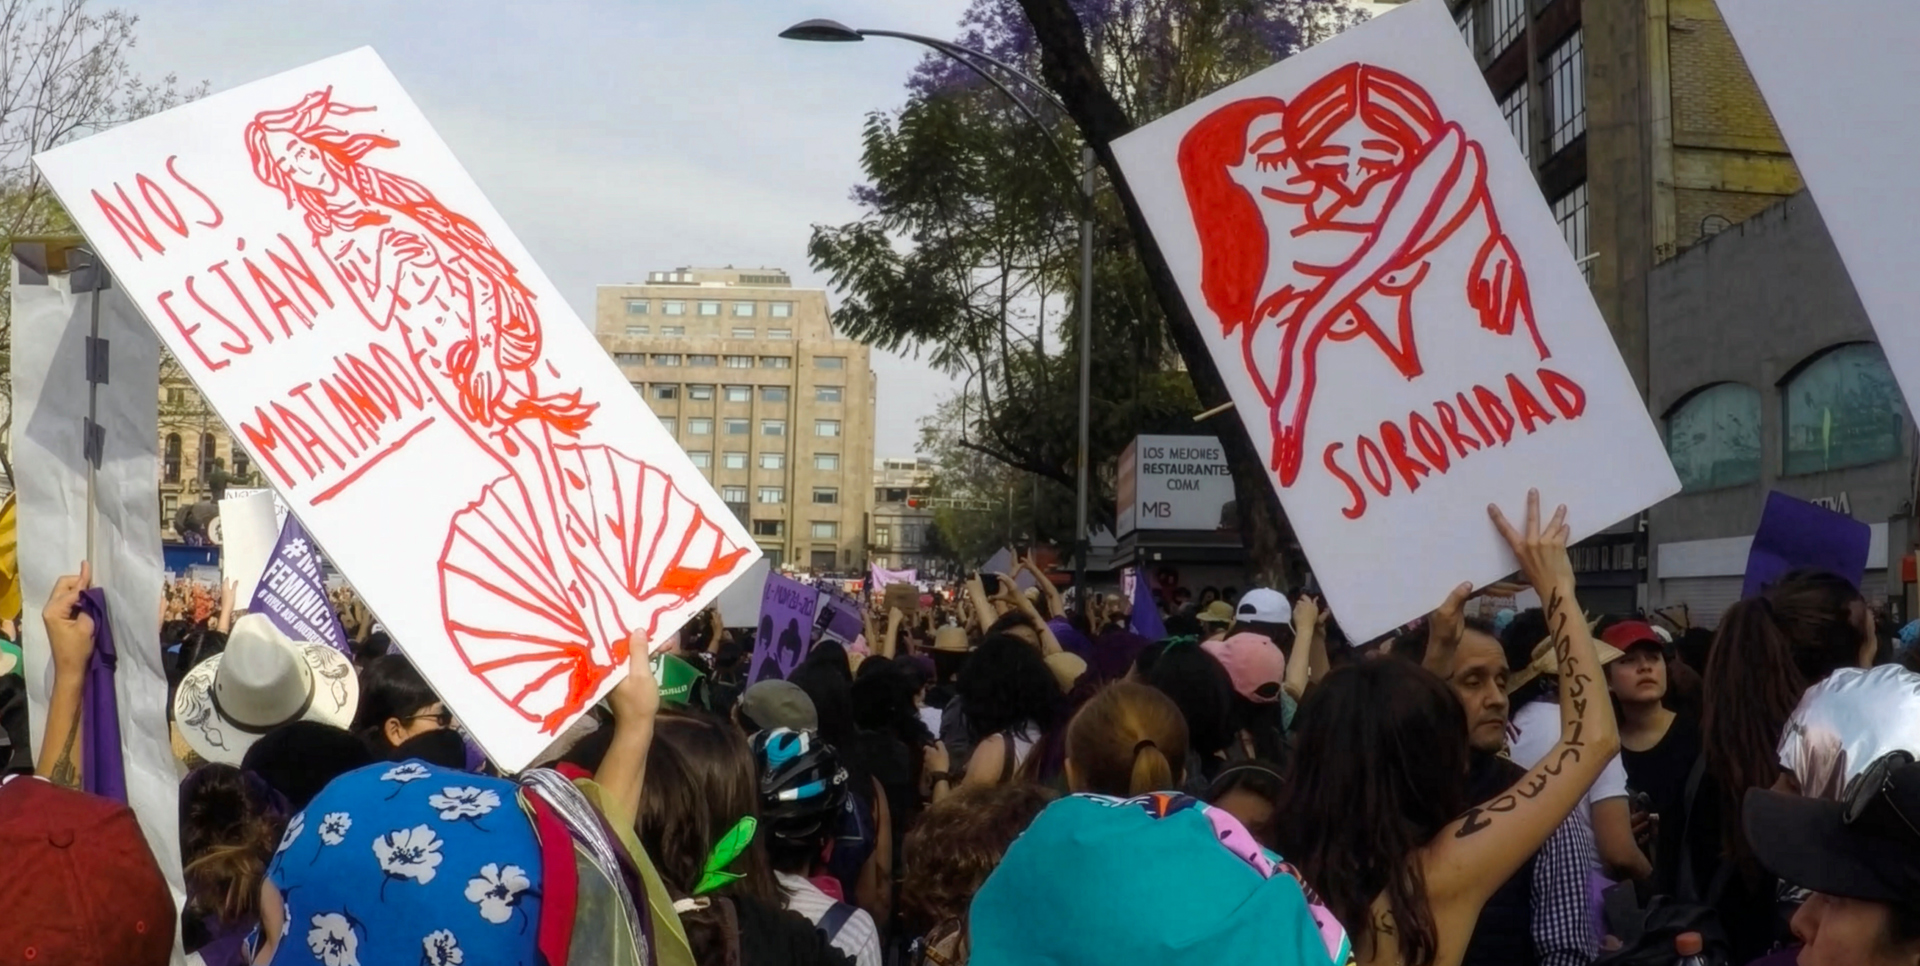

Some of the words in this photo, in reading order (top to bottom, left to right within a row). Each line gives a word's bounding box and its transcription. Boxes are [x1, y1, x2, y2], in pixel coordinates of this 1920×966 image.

[90, 155, 223, 261] NOS
[157, 233, 336, 372] ESTÁN
[1143, 447, 1164, 459] LOS
[1169, 448, 1220, 460] MEJORES
[1167, 479, 1200, 491] CDMX
[1323, 368, 1586, 519] SORORIDAD
